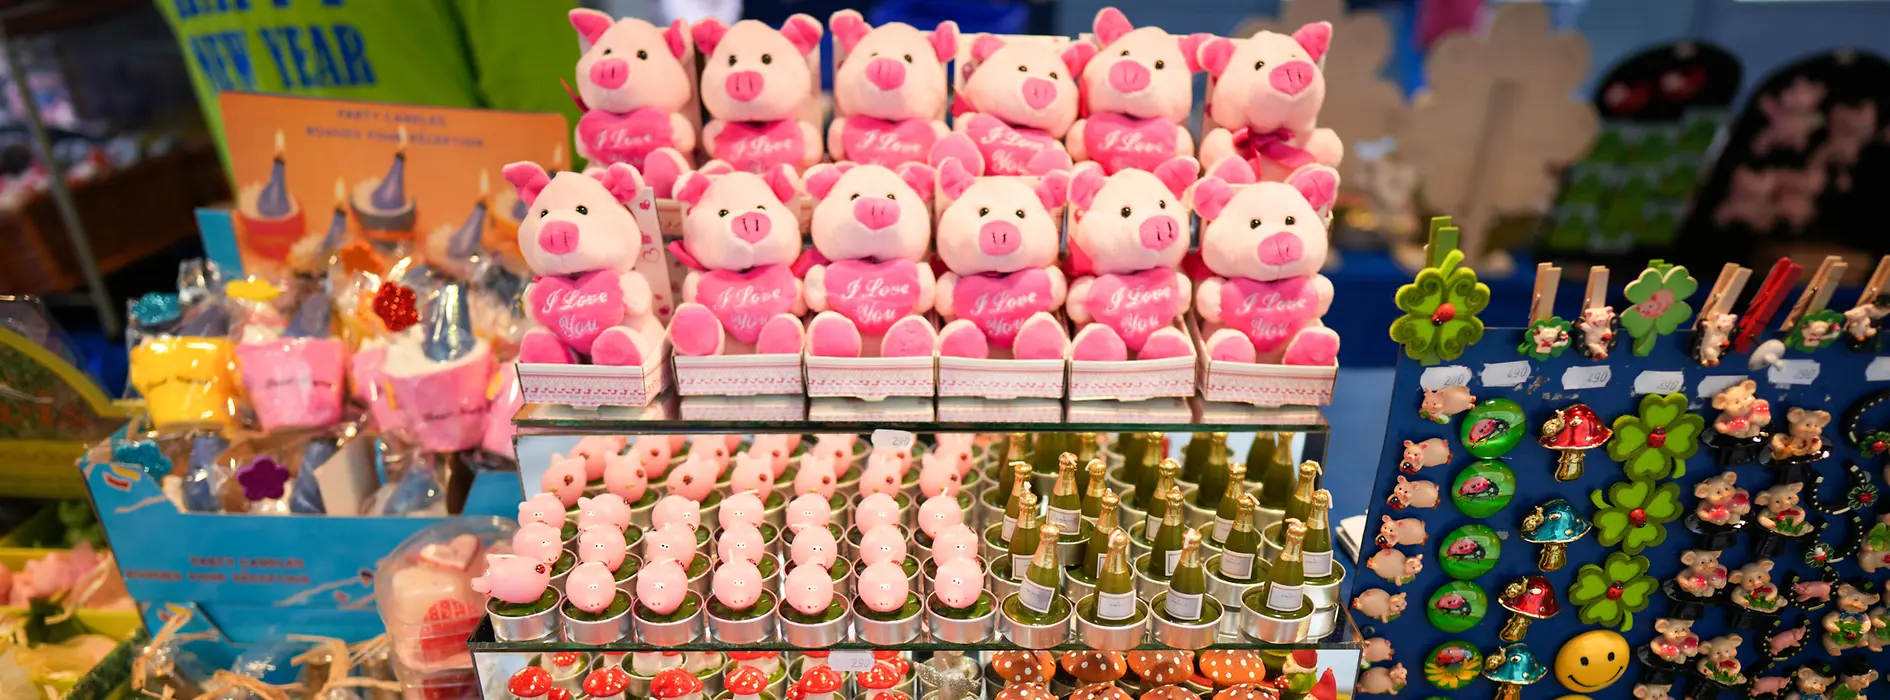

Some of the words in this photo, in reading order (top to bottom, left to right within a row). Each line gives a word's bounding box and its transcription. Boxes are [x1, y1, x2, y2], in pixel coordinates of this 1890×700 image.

[188, 29, 259, 92] NEW
[259, 24, 379, 90] YEAR
[733, 285, 782, 307] Love
[862, 276, 911, 299] Love
[1126, 285, 1172, 309] Love
[559, 288, 608, 311] Love
[988, 289, 1038, 313] Love
[1257, 291, 1308, 313] Love
[856, 301, 897, 324] You
[1120, 313, 1160, 334] You
[559, 314, 600, 338] You
